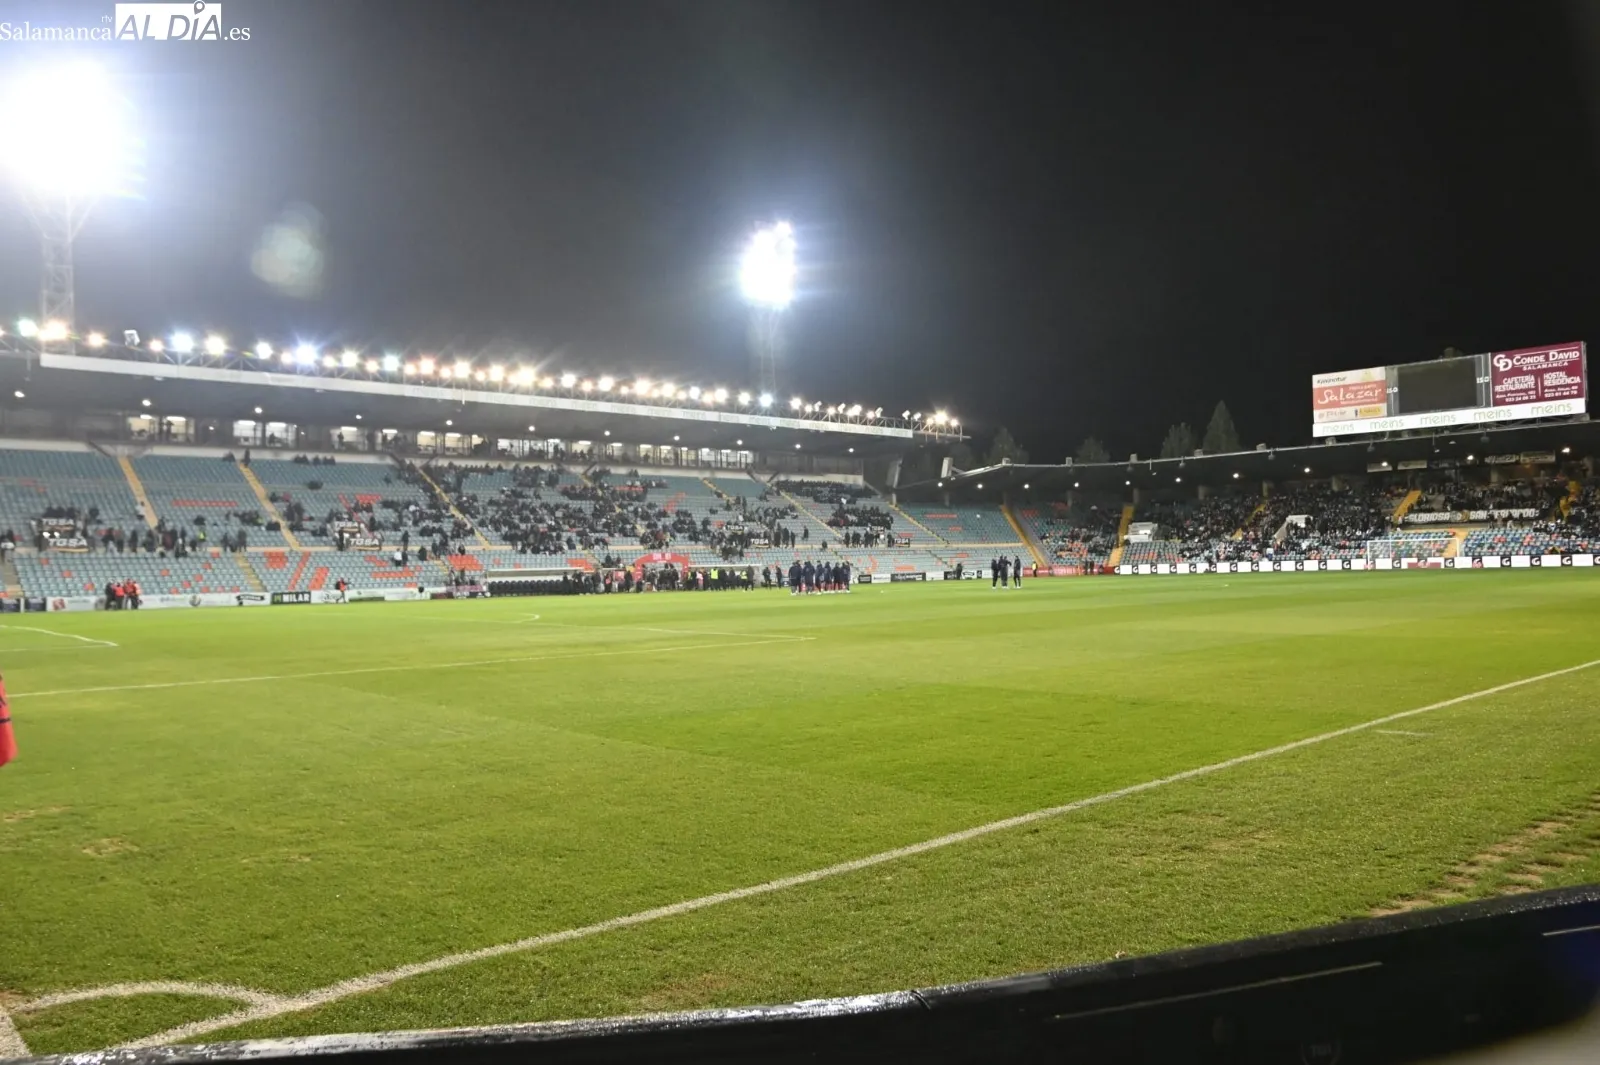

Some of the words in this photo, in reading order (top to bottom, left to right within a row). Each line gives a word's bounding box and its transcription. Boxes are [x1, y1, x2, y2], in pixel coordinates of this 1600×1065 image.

[1513, 355, 1545, 366] CONDE
[1549, 351, 1580, 361] DAVID
[1523, 361, 1568, 371] SALAMANCA
[1503, 374, 1535, 385] CAFETERÍA
[1544, 371, 1567, 380] HOSTAL
[1495, 382, 1536, 392] RESTAURANTE
[1544, 376, 1581, 387] RESIDENCIA
[1317, 387, 1382, 405] Salazar
[1323, 423, 1354, 433] meins
[1370, 418, 1404, 430] meins
[1420, 413, 1456, 426] meins
[1474, 407, 1512, 421] meins
[1531, 402, 1573, 416] meins
[282, 593, 310, 602] MILAR
